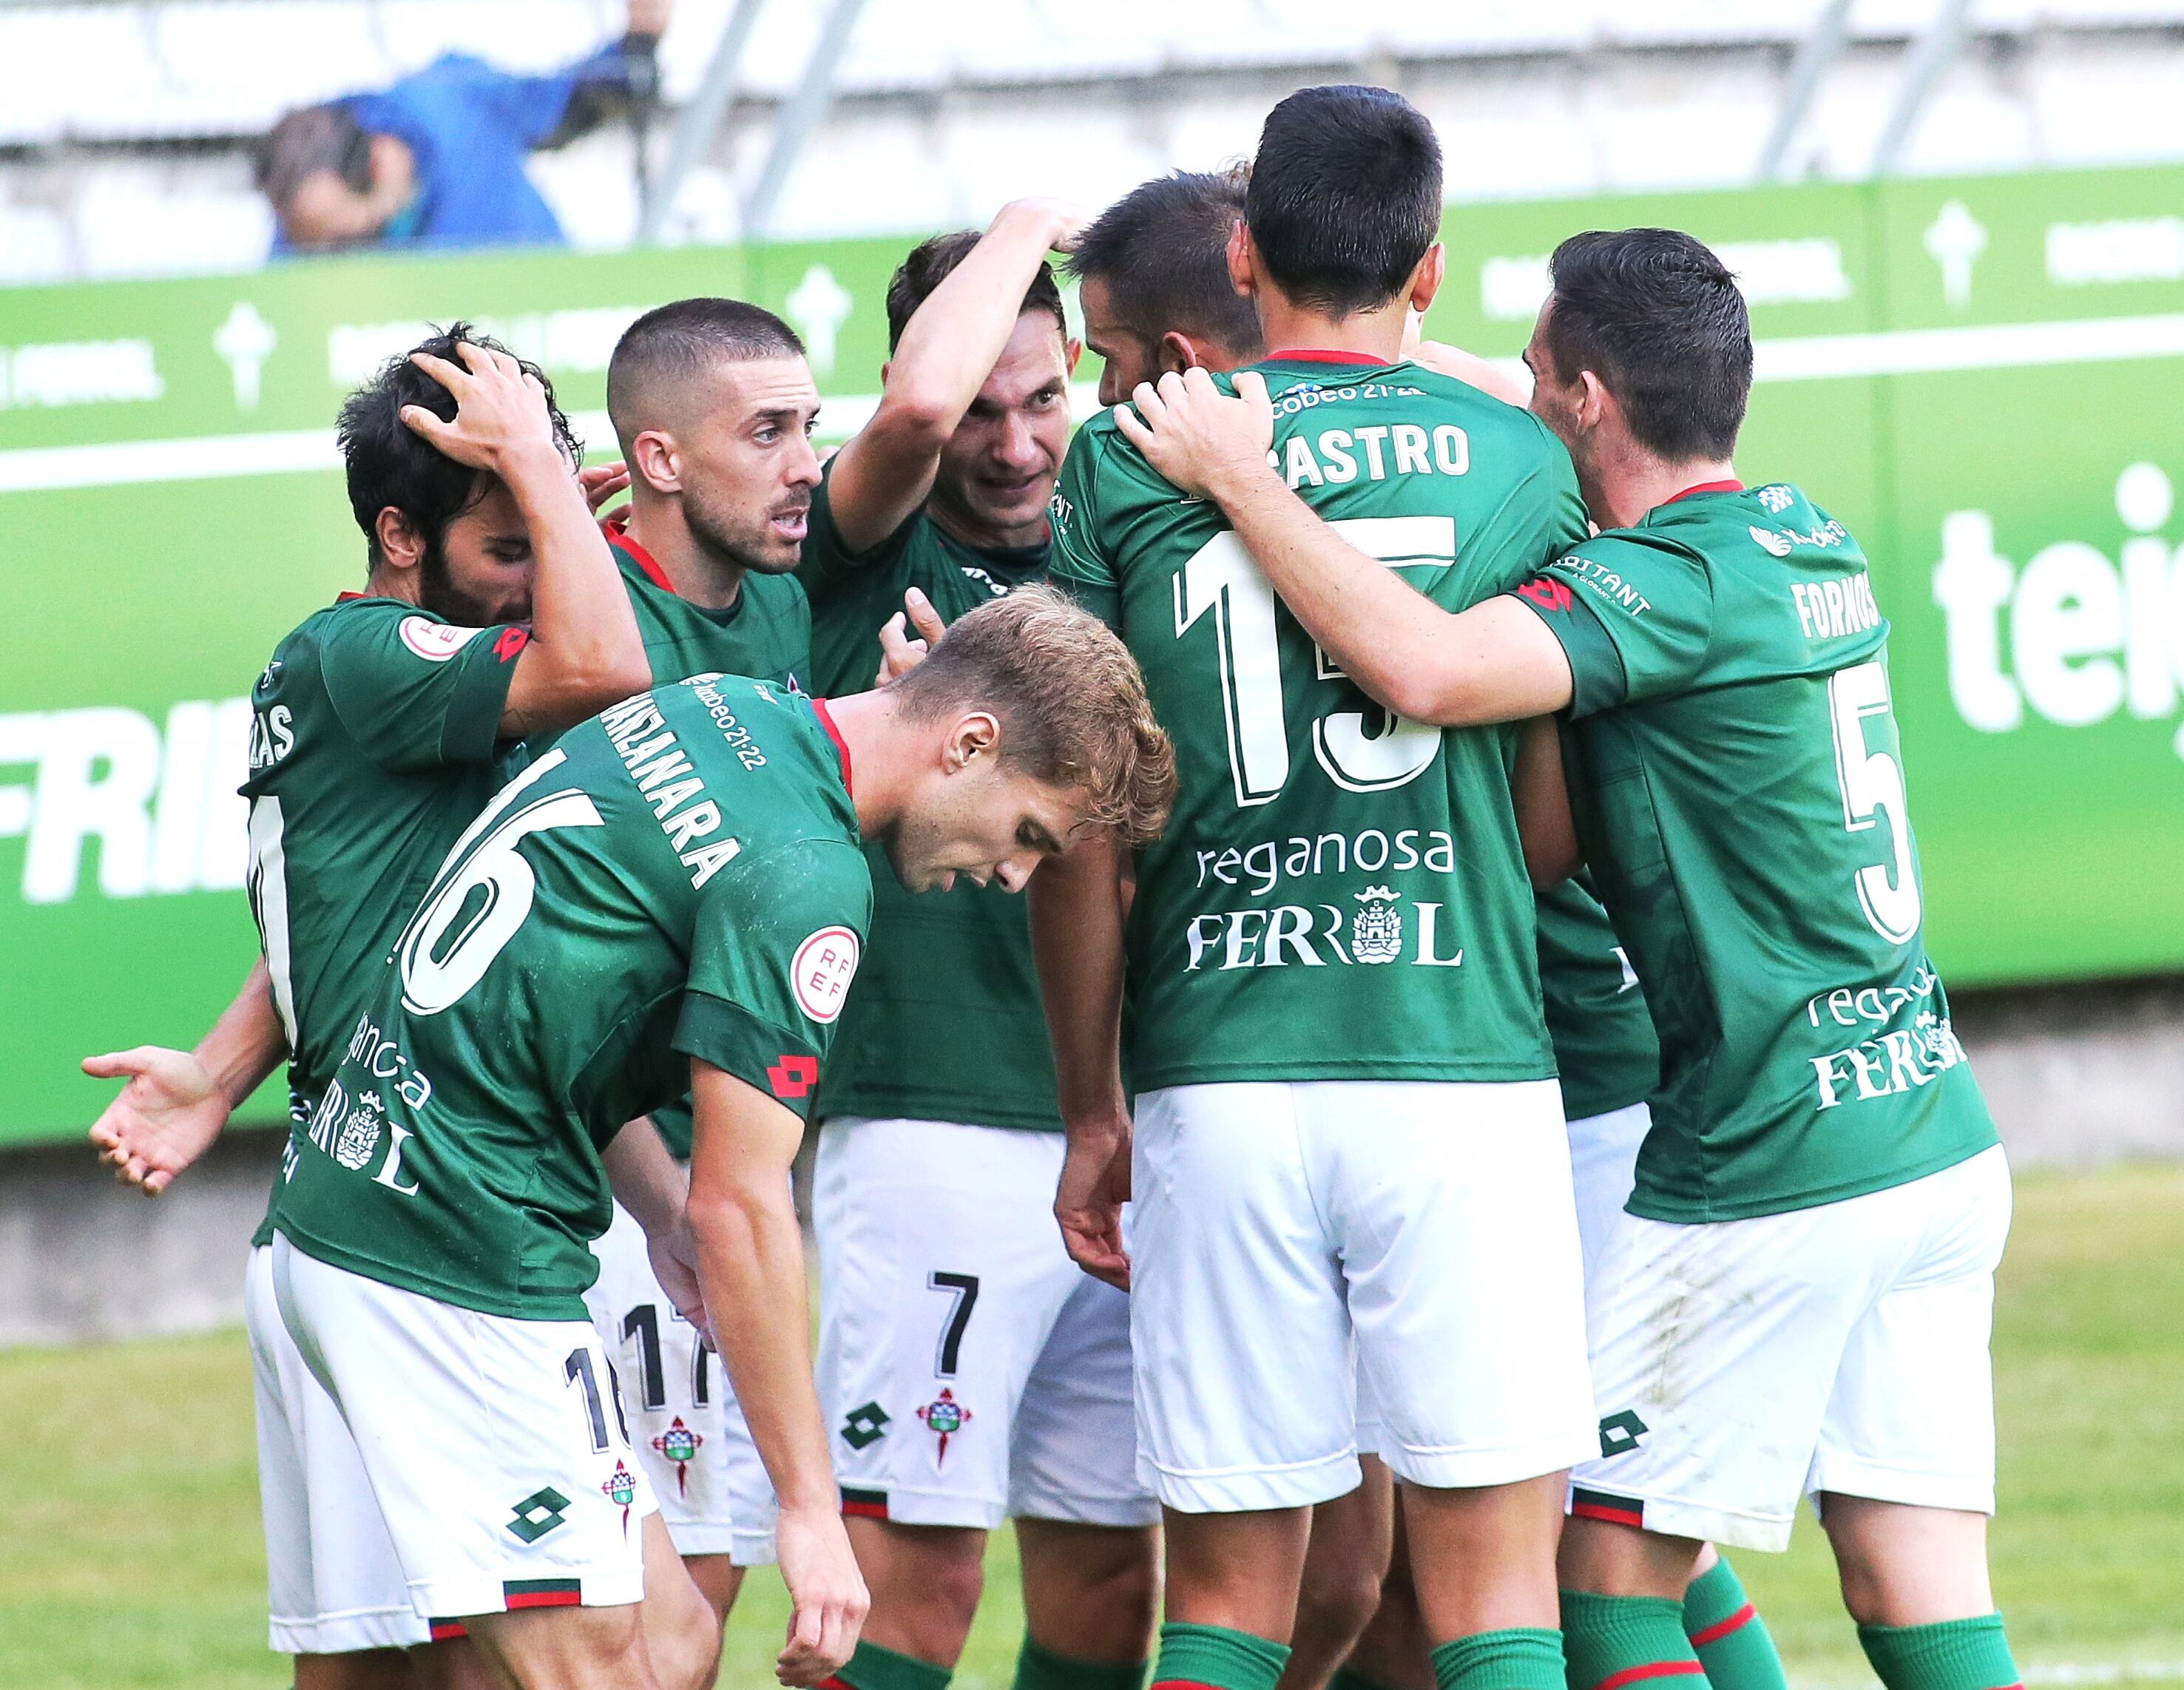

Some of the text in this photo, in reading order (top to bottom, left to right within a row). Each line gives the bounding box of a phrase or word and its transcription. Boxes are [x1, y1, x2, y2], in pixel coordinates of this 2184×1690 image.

[1172, 516, 1456, 808] 15
[1790, 569, 1879, 639] FORNOS
[1932, 461, 2184, 734] tei
[385, 747, 606, 1016] 16
[1196, 829, 1456, 896] reganosa
[1827, 662, 1924, 945] 5
[927, 1270, 981, 1379] 7
